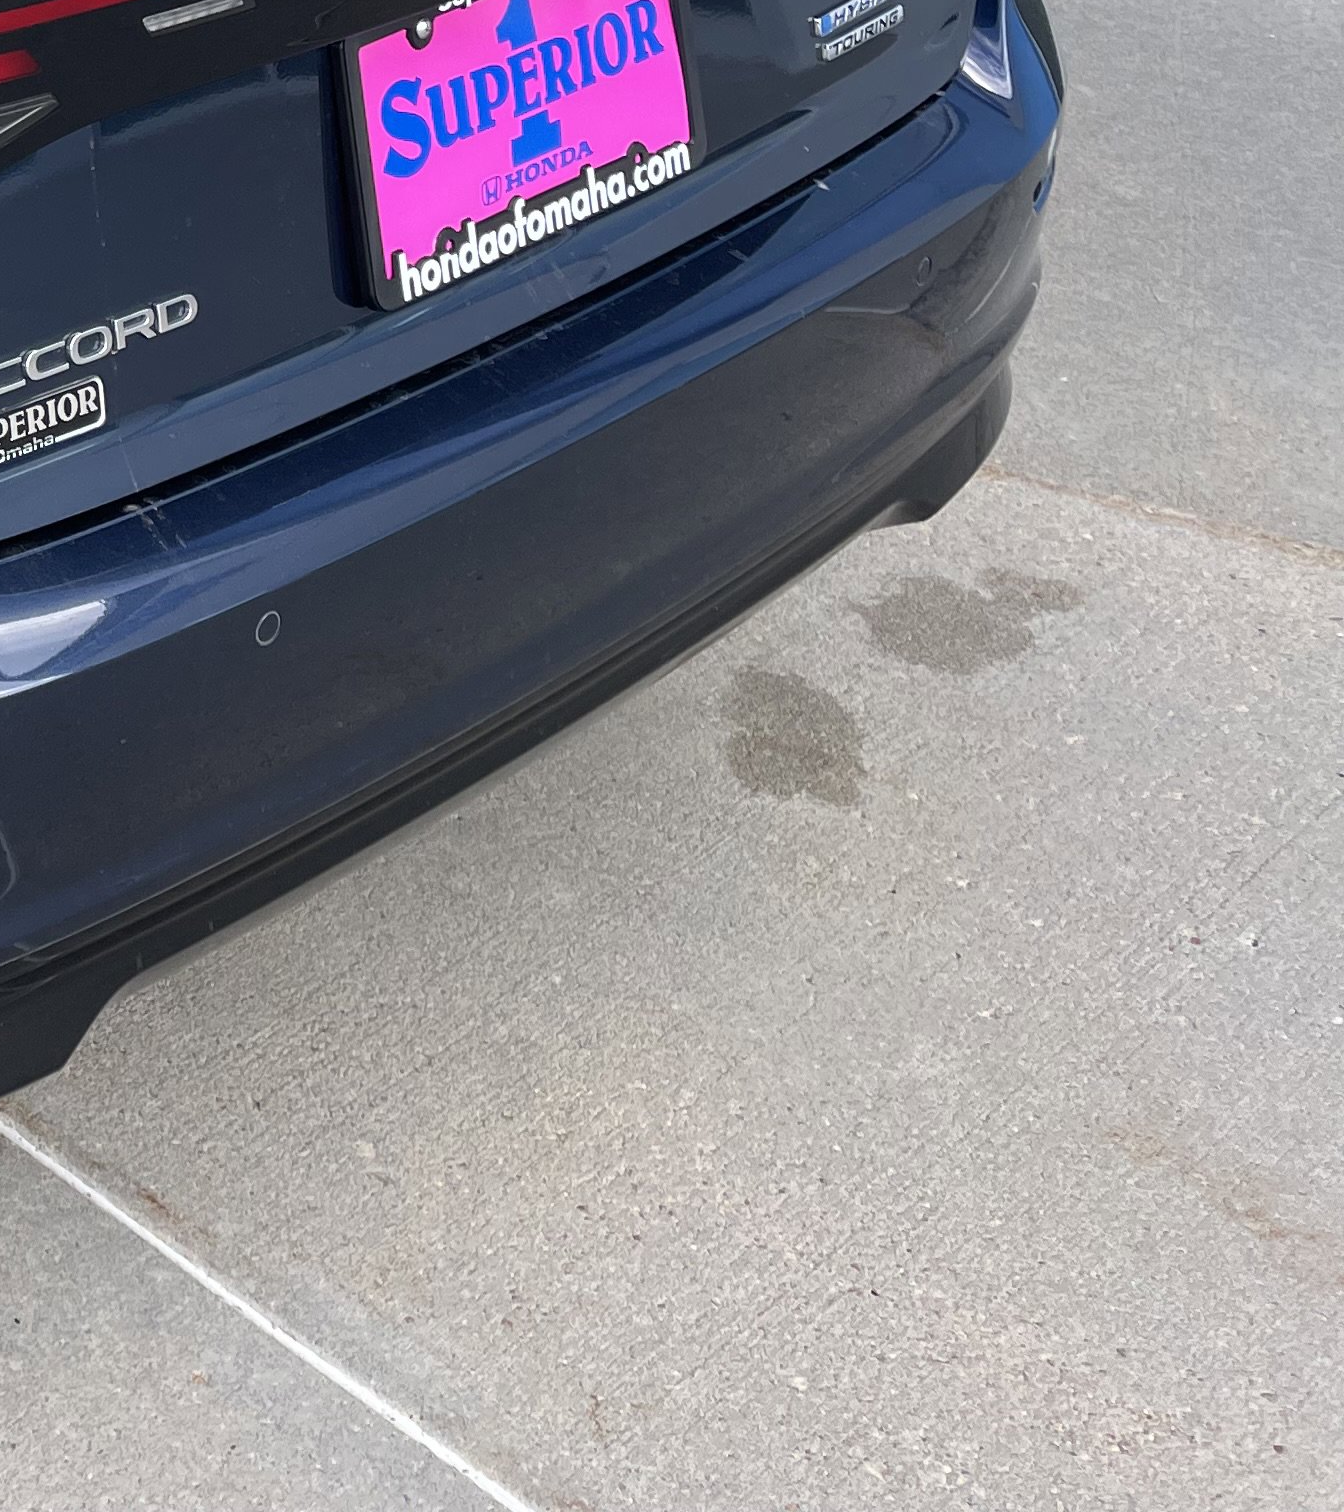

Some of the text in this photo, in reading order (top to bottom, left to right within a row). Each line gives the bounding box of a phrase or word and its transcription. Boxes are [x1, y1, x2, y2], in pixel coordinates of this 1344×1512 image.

[831, 9, 899, 56] TOURING
[381, 0, 664, 178] SUPERIOR
[504, 140, 594, 192] HONDA
[398, 142, 691, 303] hondaofomaha.com
